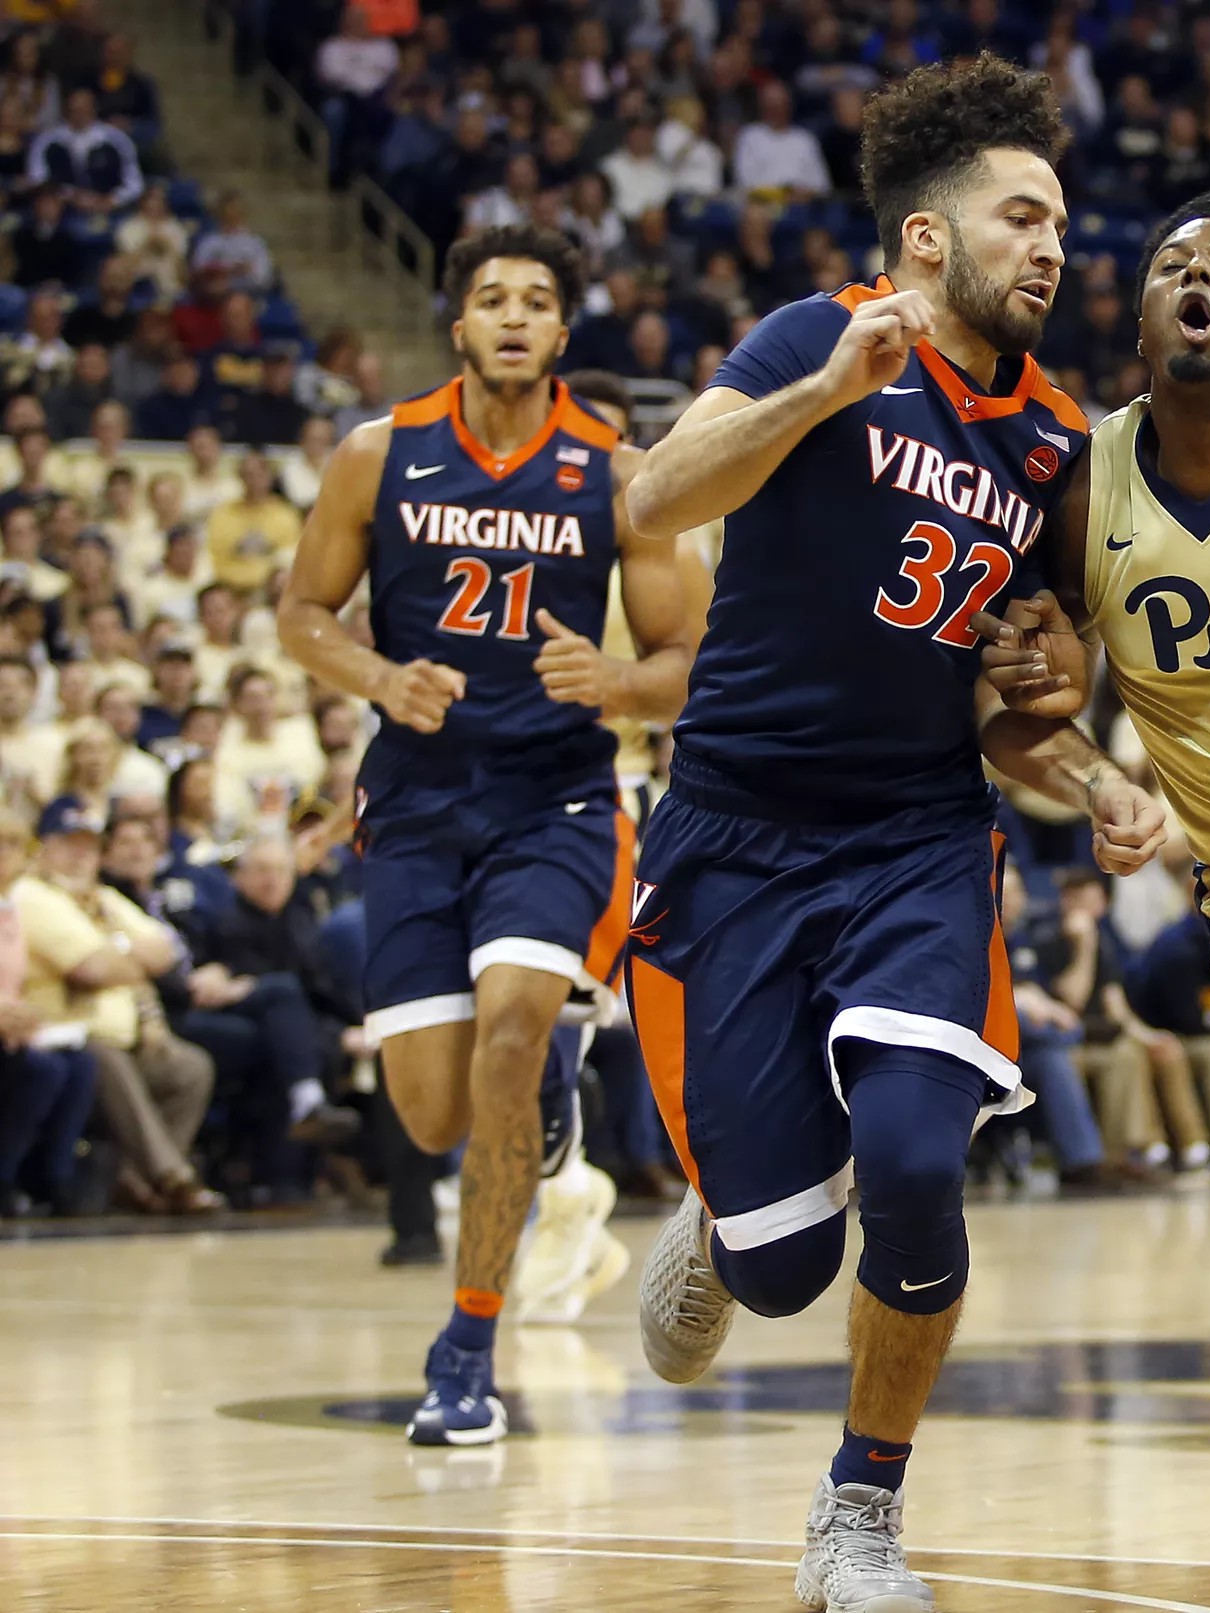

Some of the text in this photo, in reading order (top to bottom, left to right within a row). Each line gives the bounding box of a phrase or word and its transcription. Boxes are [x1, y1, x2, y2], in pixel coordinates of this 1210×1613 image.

[399, 502, 585, 556] VIRGINIA
[436, 556, 536, 640] 21
[873, 520, 1014, 650] 32
